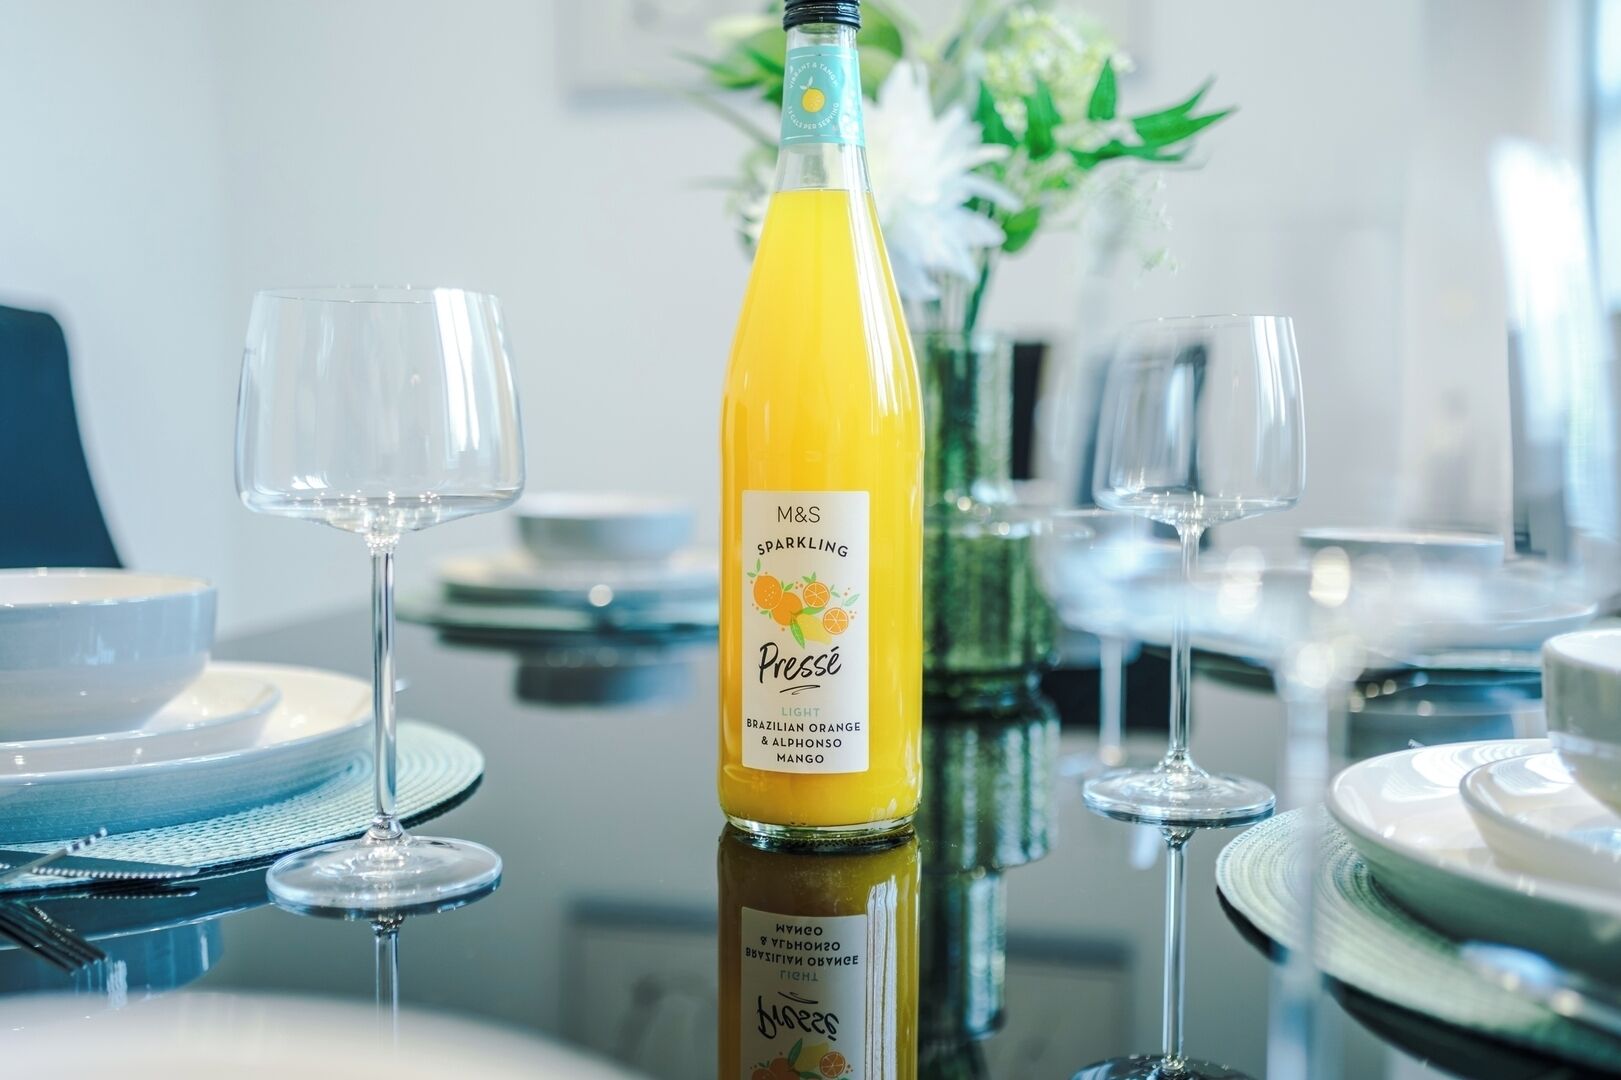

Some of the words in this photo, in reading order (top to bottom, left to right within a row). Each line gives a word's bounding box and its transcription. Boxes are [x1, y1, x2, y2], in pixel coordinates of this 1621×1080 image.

[789, 63, 810, 88] VIBRANT
[819, 64, 840, 87] TANGY
[818, 103, 839, 128] SERVING
[777, 506, 821, 523] M&S
[757, 536, 848, 557] SPARKLING
[759, 642, 842, 684] Pressé
[782, 707, 820, 717] LIGHT
[747, 718, 804, 732] BRAZILIAN
[809, 722, 860, 732] ORANGE
[761, 736, 768, 745] &
[772, 738, 842, 748] ALPHONSO
[777, 753, 824, 763] MANGO
